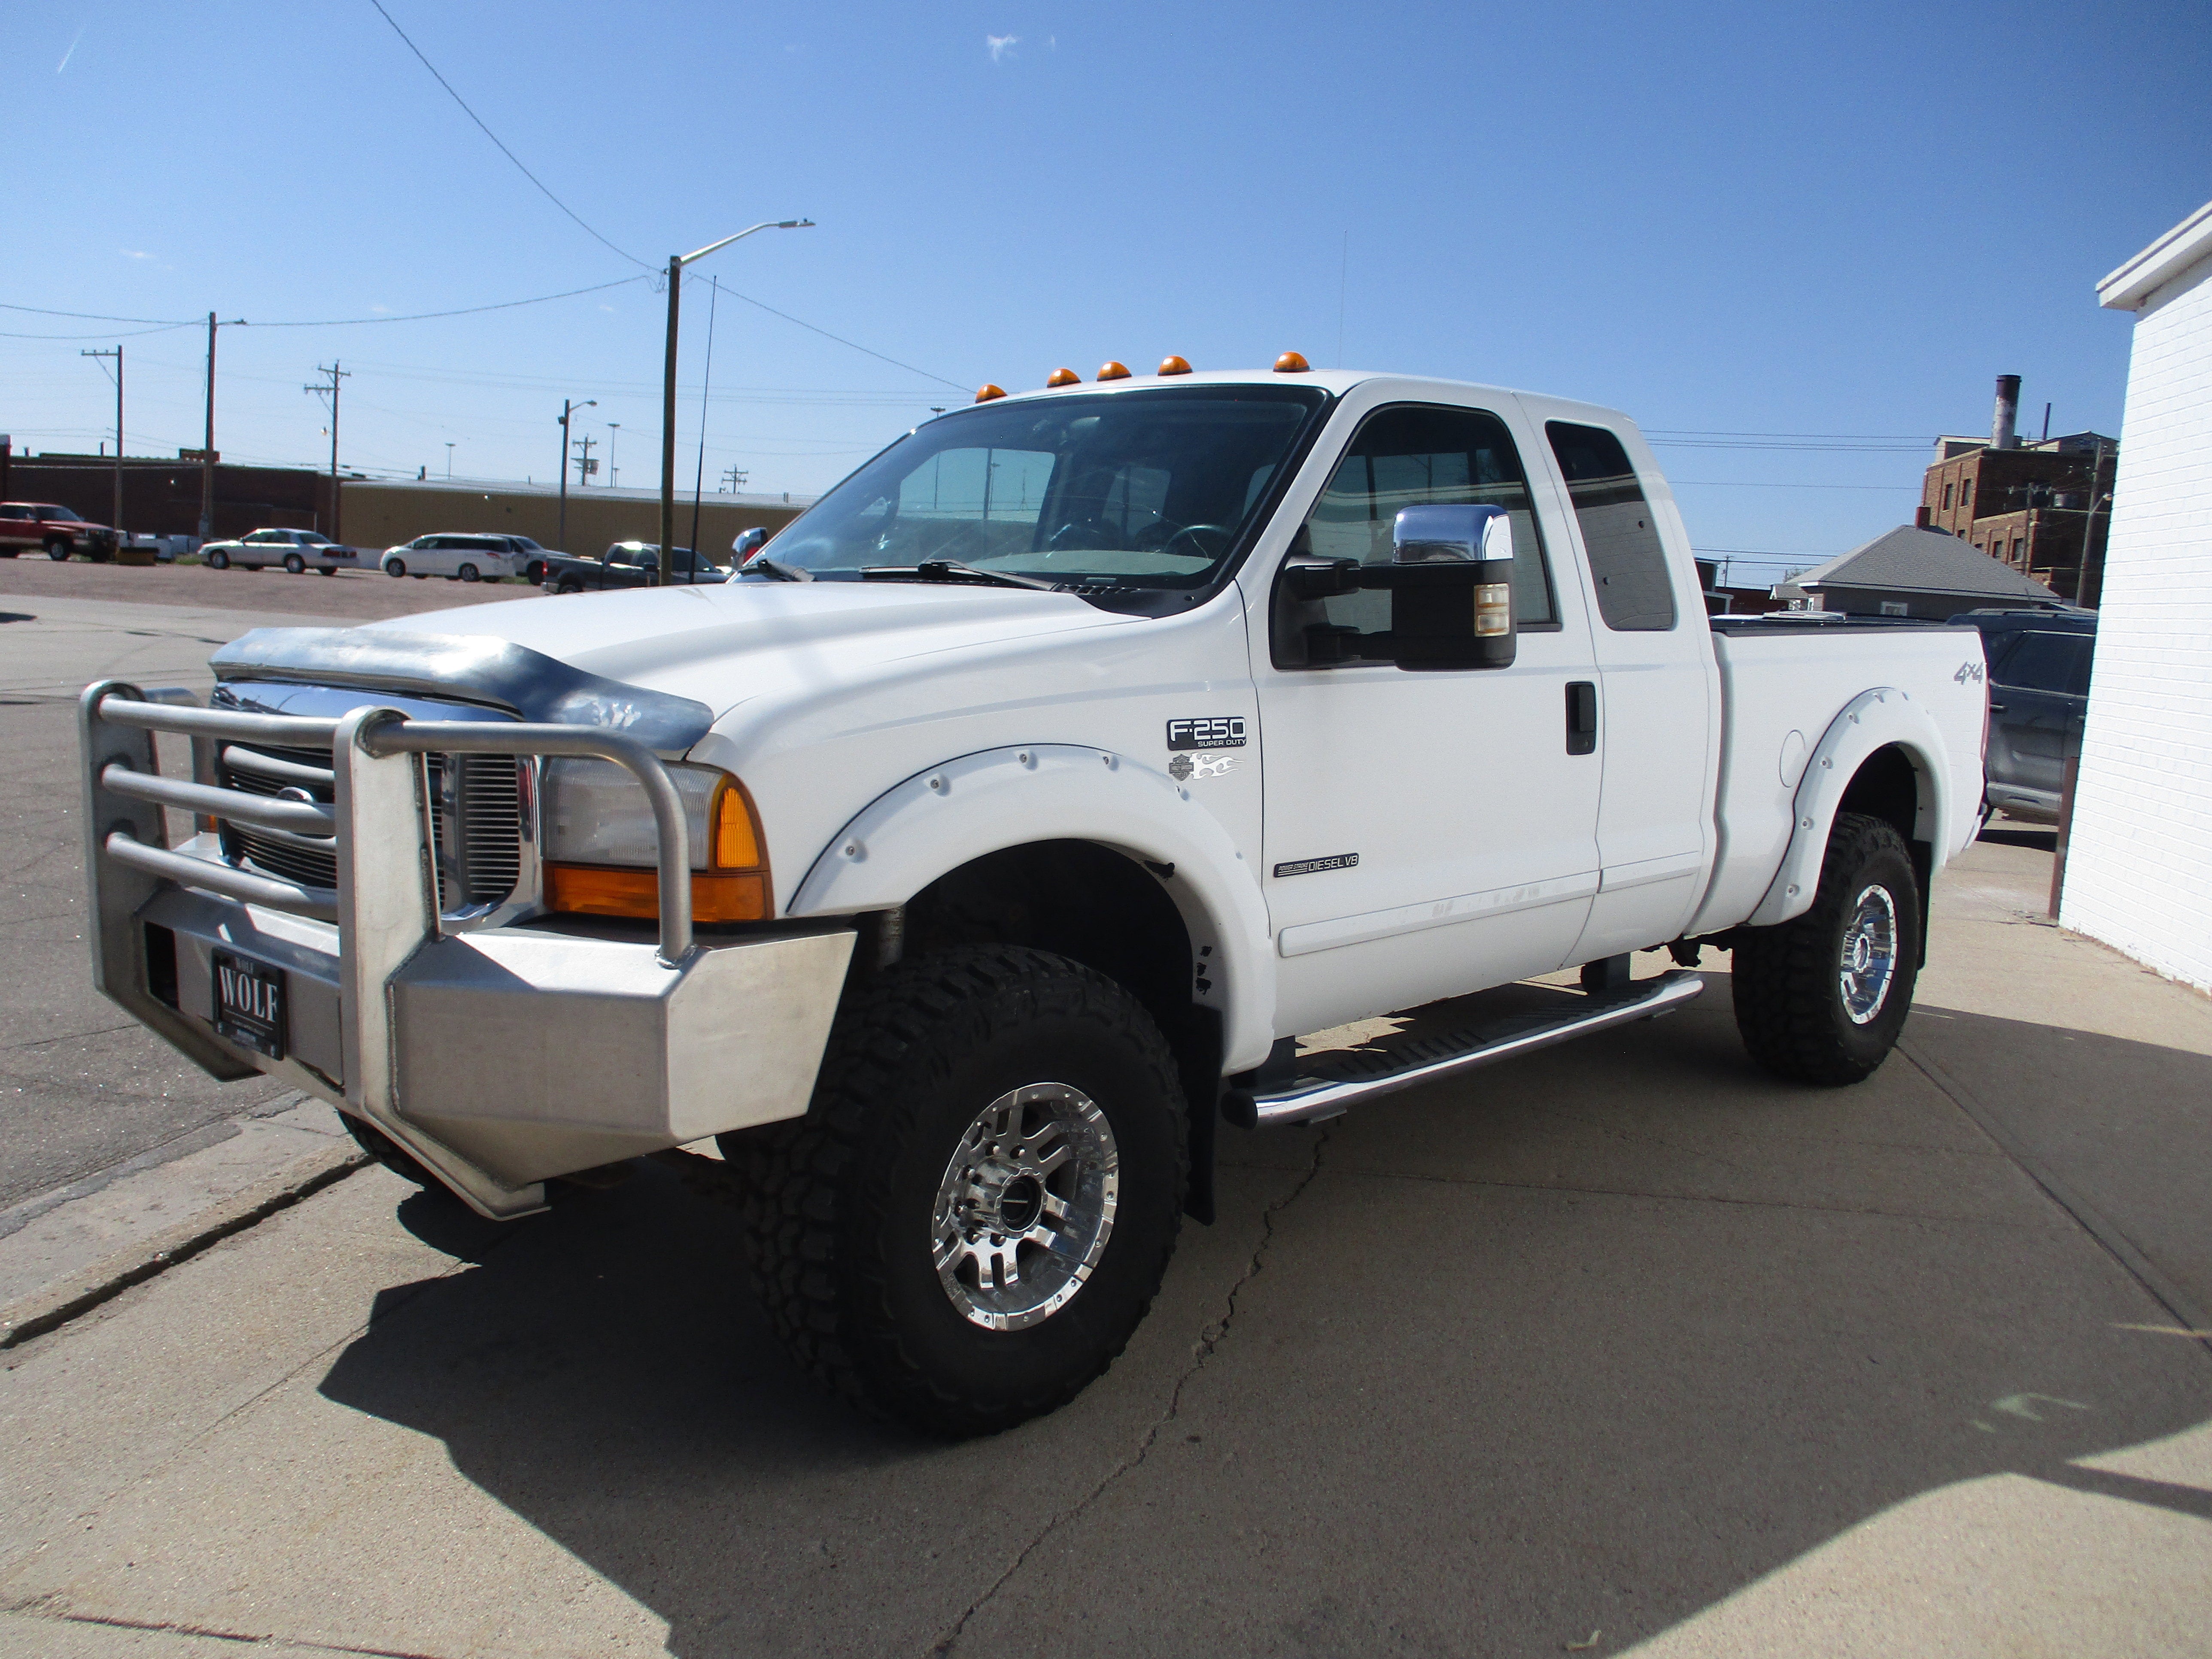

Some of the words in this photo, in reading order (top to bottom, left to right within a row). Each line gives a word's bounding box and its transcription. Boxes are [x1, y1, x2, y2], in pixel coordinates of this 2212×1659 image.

[1309, 857, 1343, 871] DIESEL
[1345, 855, 1358, 866] V8
[219, 965, 277, 1023] WOLF
